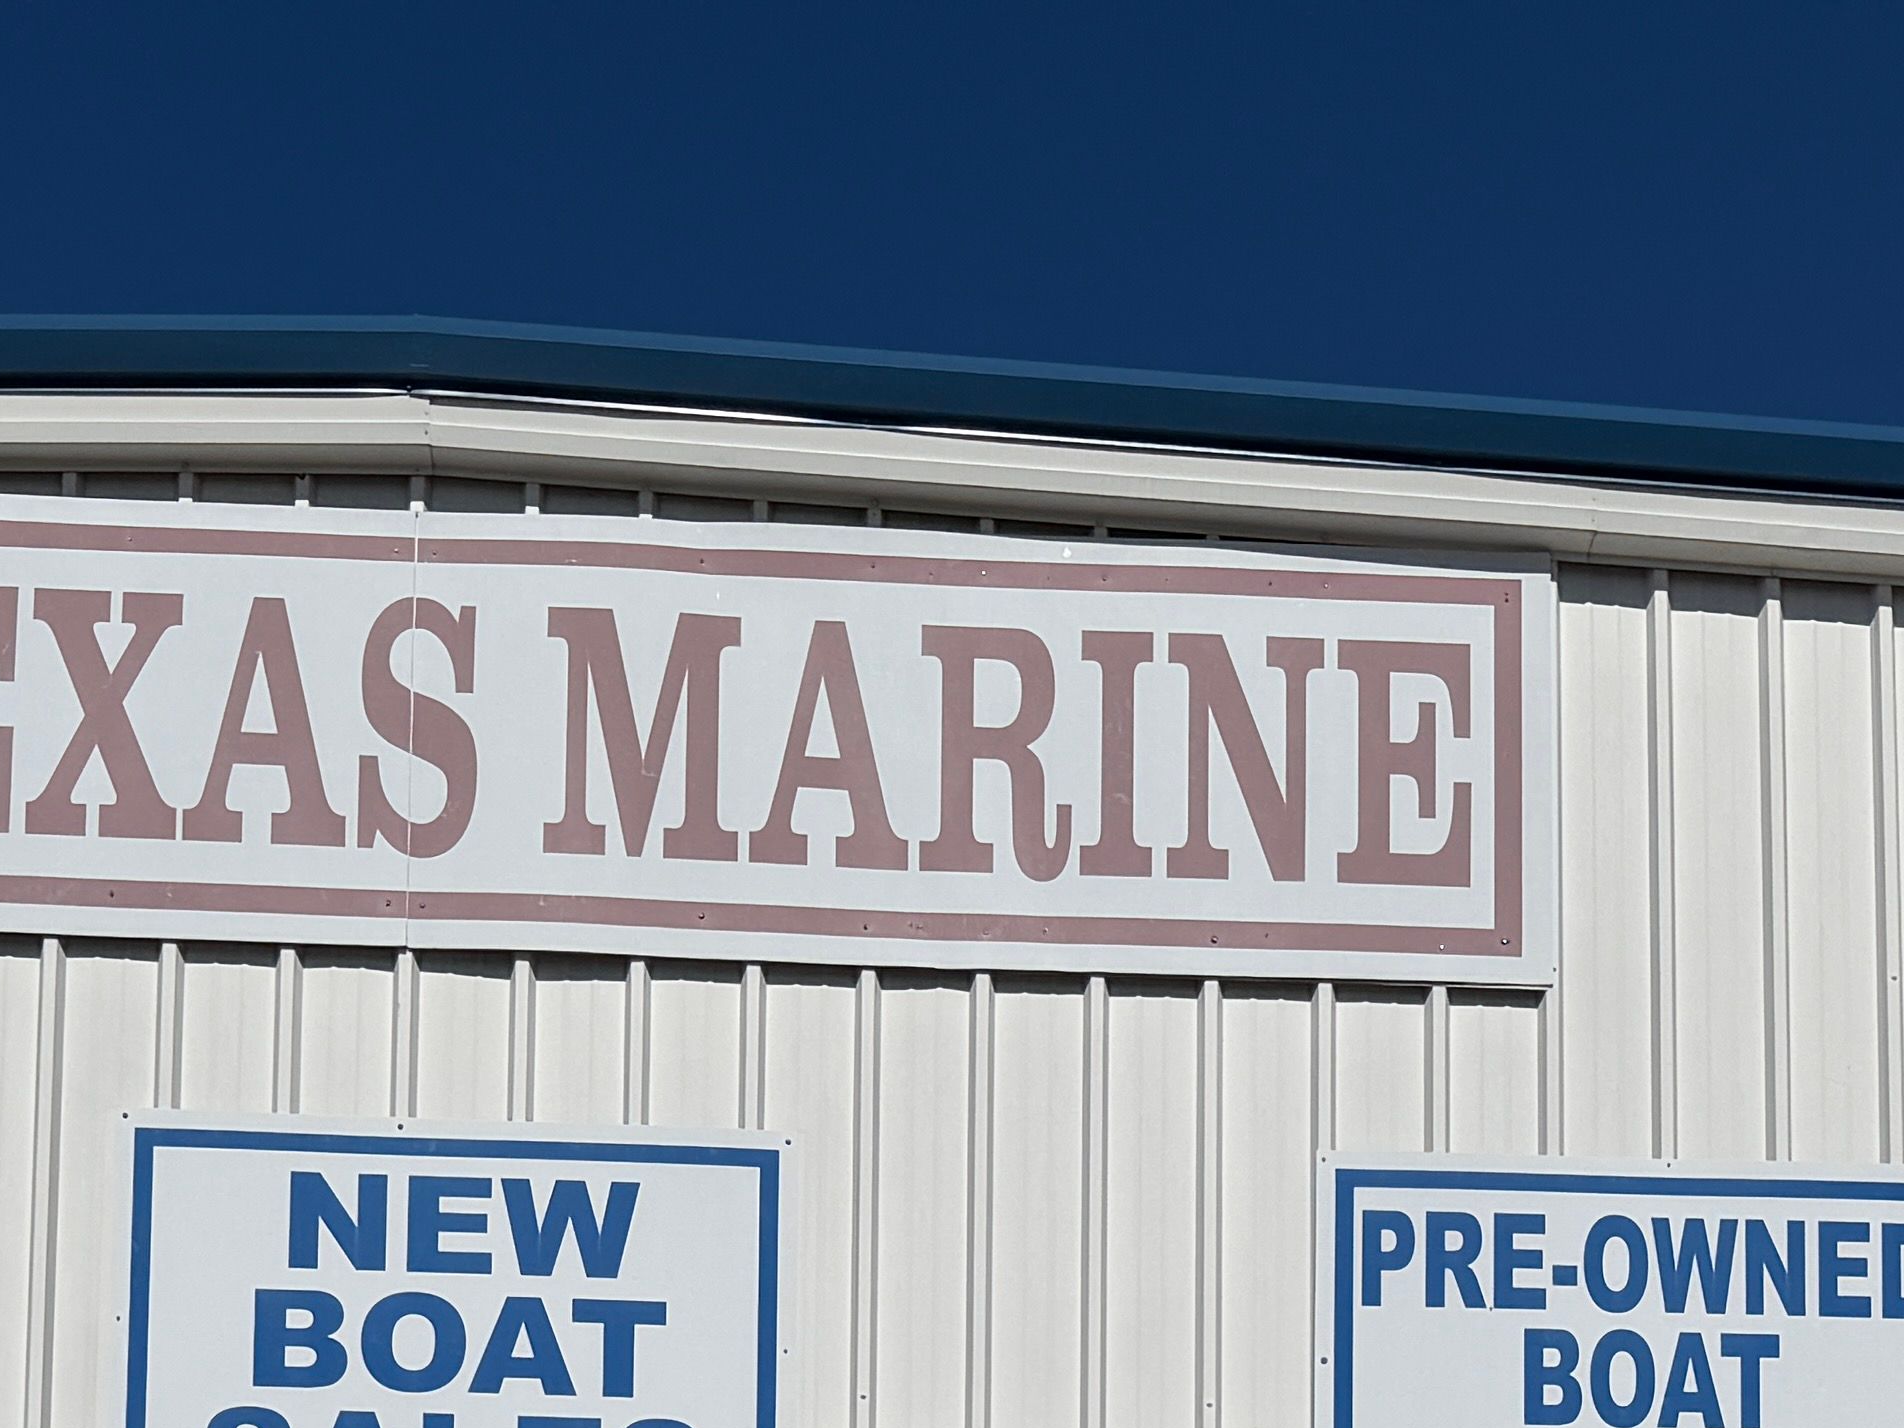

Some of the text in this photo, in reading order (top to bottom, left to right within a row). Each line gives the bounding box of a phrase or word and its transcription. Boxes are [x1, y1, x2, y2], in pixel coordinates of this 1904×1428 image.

[544, 605, 1476, 884] MARINE
[288, 1171, 641, 1278] NEW
[253, 1289, 667, 1398] BOAT
